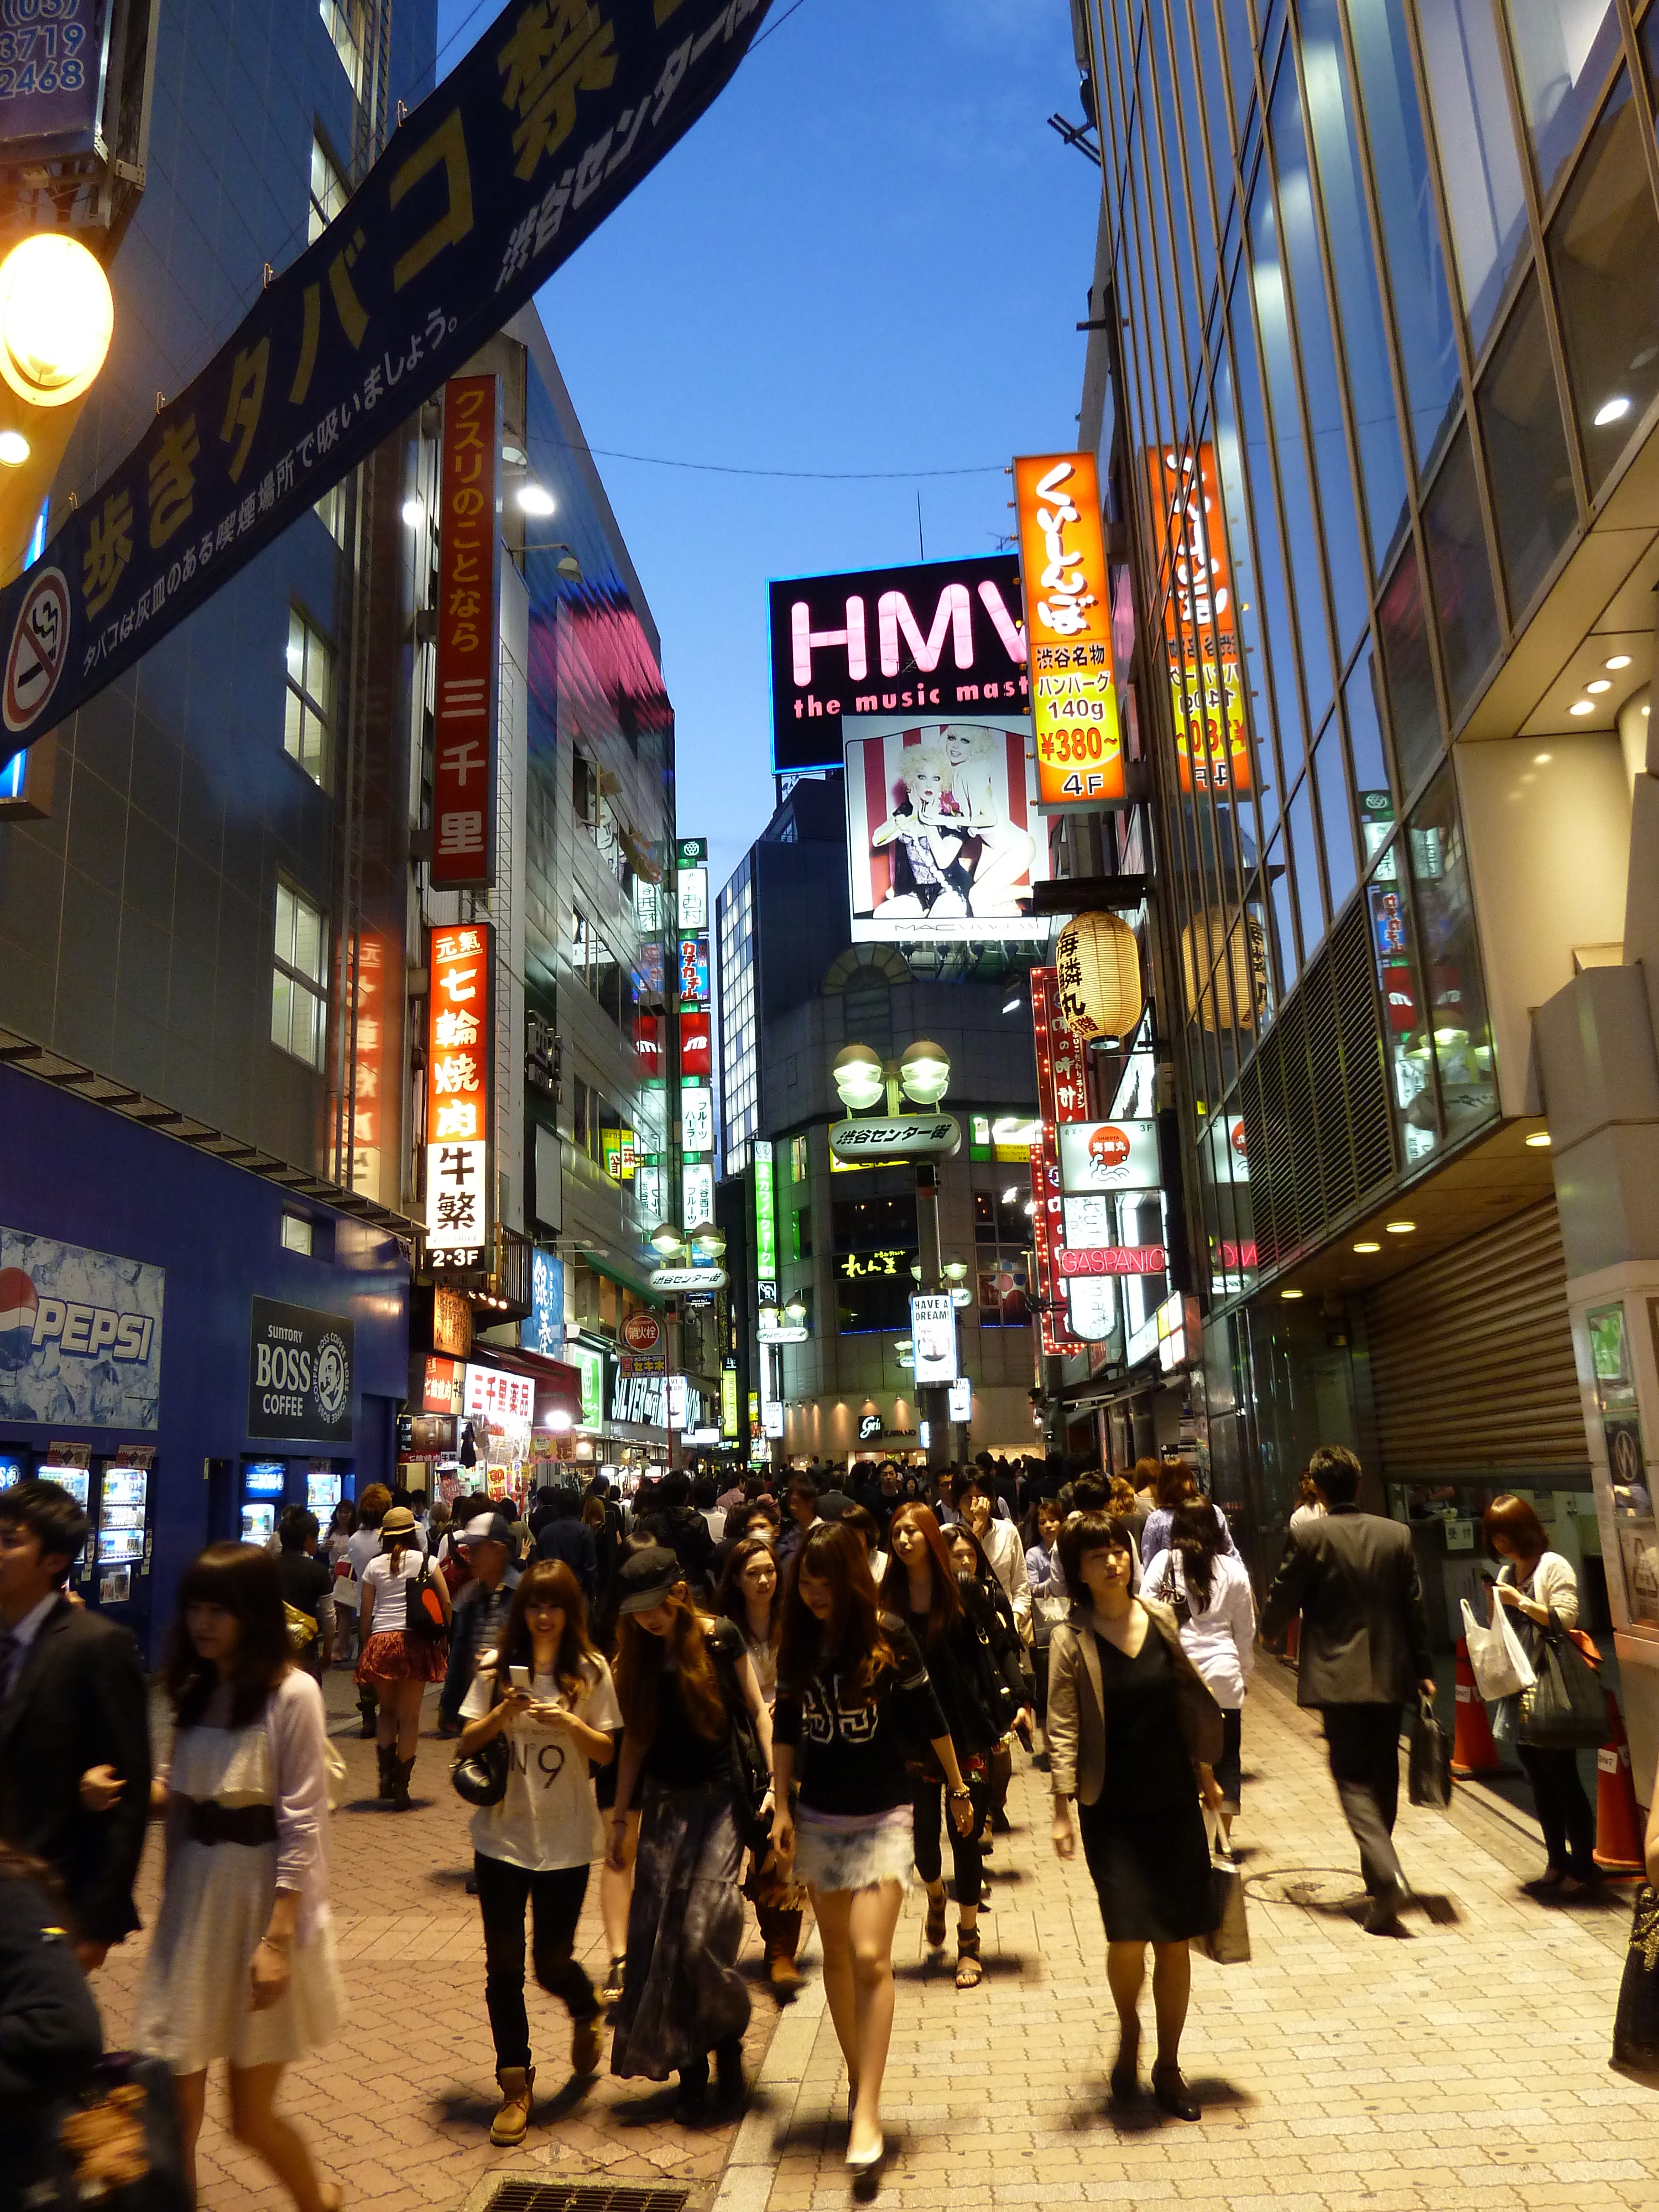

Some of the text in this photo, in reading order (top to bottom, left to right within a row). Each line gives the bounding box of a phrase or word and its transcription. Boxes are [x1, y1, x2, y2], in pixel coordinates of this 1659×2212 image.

[0, 59, 84, 101] 2468
[82, 0, 688, 622] 歩きタバコ禁
[438, 389, 487, 855] クスリのことなら 三千里
[1036, 644, 1105, 670] 渋谷名物
[794, 695, 841, 718] the
[855, 682, 940, 713] music
[1048, 699, 1104, 721] 140g
[1062, 773, 1103, 795] 4F
[681, 942, 700, 1000] カチカチ山
[683, 1035, 708, 1052] JTB
[1052, 1017, 1077, 1121] 味の時計
[697, 1102, 707, 1140] フルーツ
[836, 1124, 952, 1145] 渋谷センター街
[1140, 1124, 1153, 1132] 3F
[436, 1147, 477, 1230] 牛繁
[687, 1187, 697, 1224] フルーツ
[1061, 1248, 1165, 1272] GASPANIC
[653, 1272, 722, 1285] 渋谷センター街
[915, 1300, 949, 1311] HAVE A
[915, 1310, 950, 1321] DREAM!
[32, 1296, 154, 1364] PEPSI
[629, 1326, 656, 1339] 消火栓
[256, 1343, 311, 1392] BOSS
[634, 1360, 664, 1371] セキネ
[263, 1393, 304, 1417] COFFEE
[472, 1374, 529, 1417] 三千里薬品
[538, 1744, 565, 1789] 9
